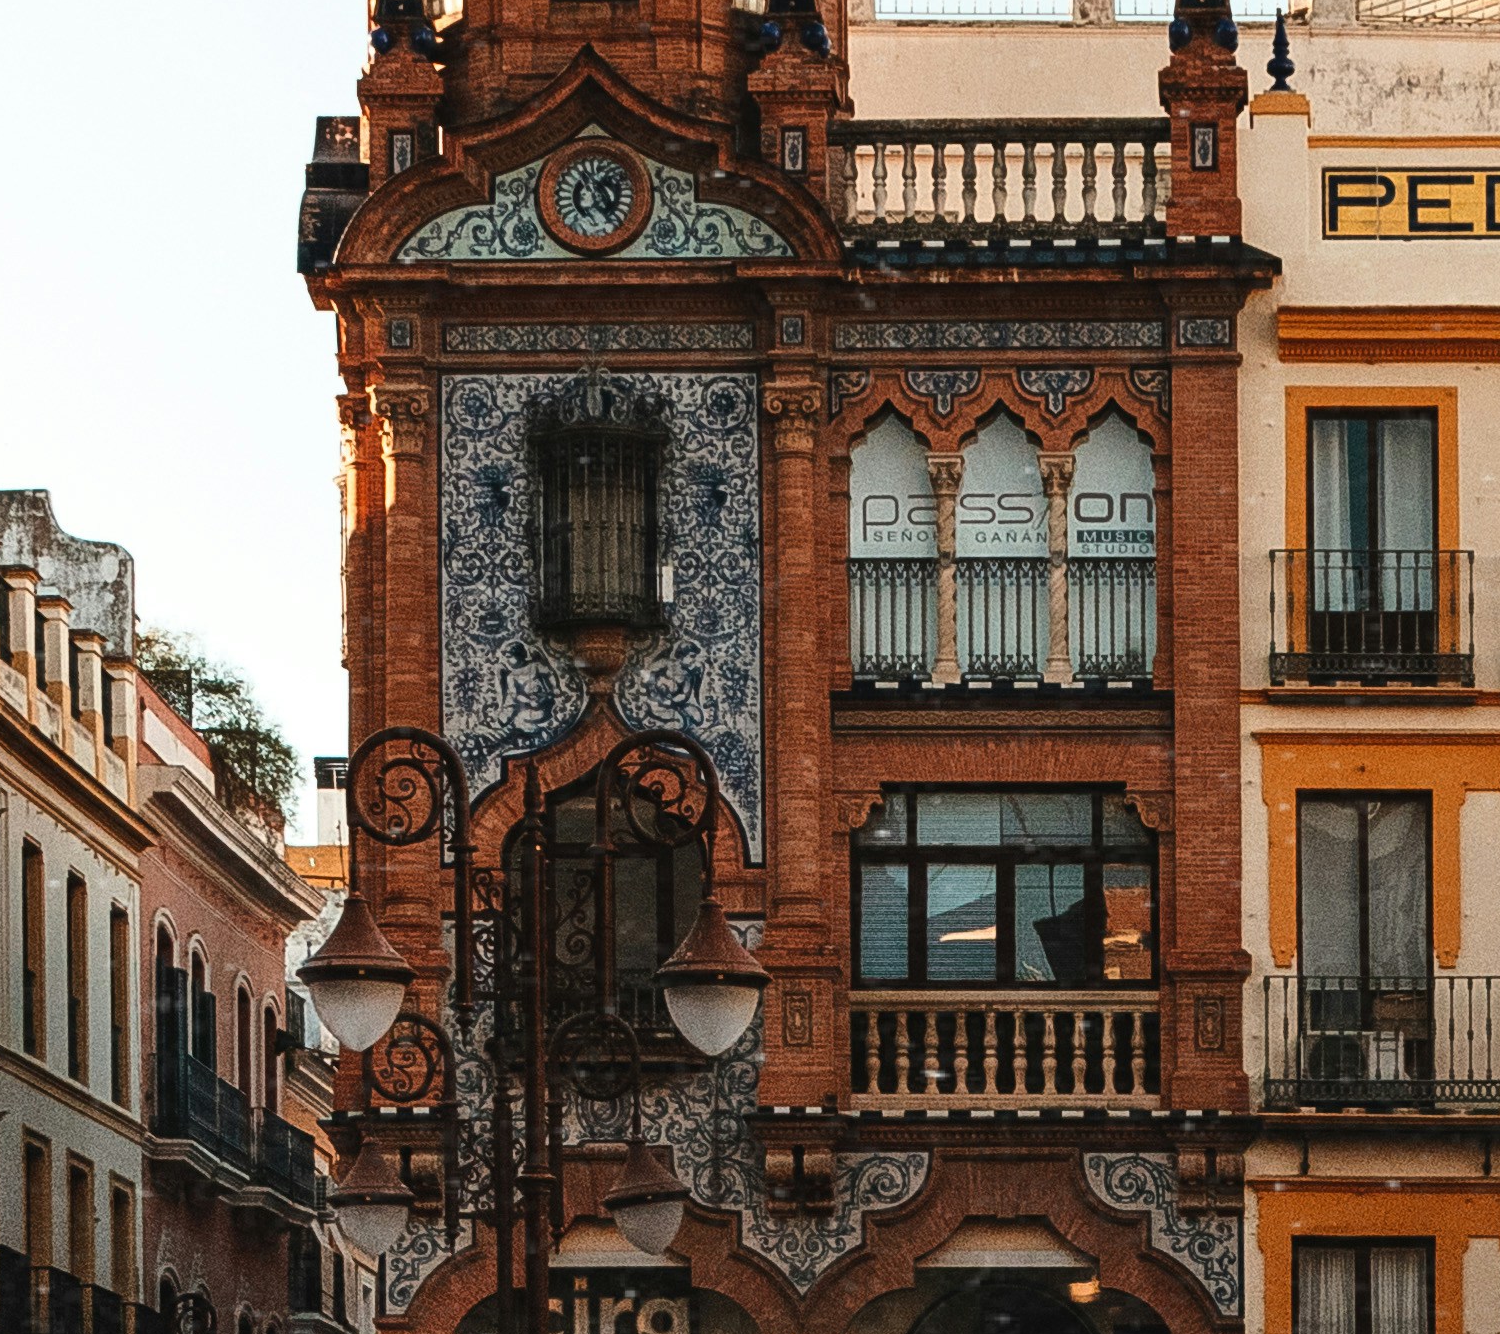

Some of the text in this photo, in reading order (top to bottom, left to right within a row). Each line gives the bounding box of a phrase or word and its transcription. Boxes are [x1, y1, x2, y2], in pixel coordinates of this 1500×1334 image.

[975, 527, 1047, 543] GAÑÁN
[1083, 532, 1149, 543] MUSIC
[1080, 544, 1150, 554] STUDIO
